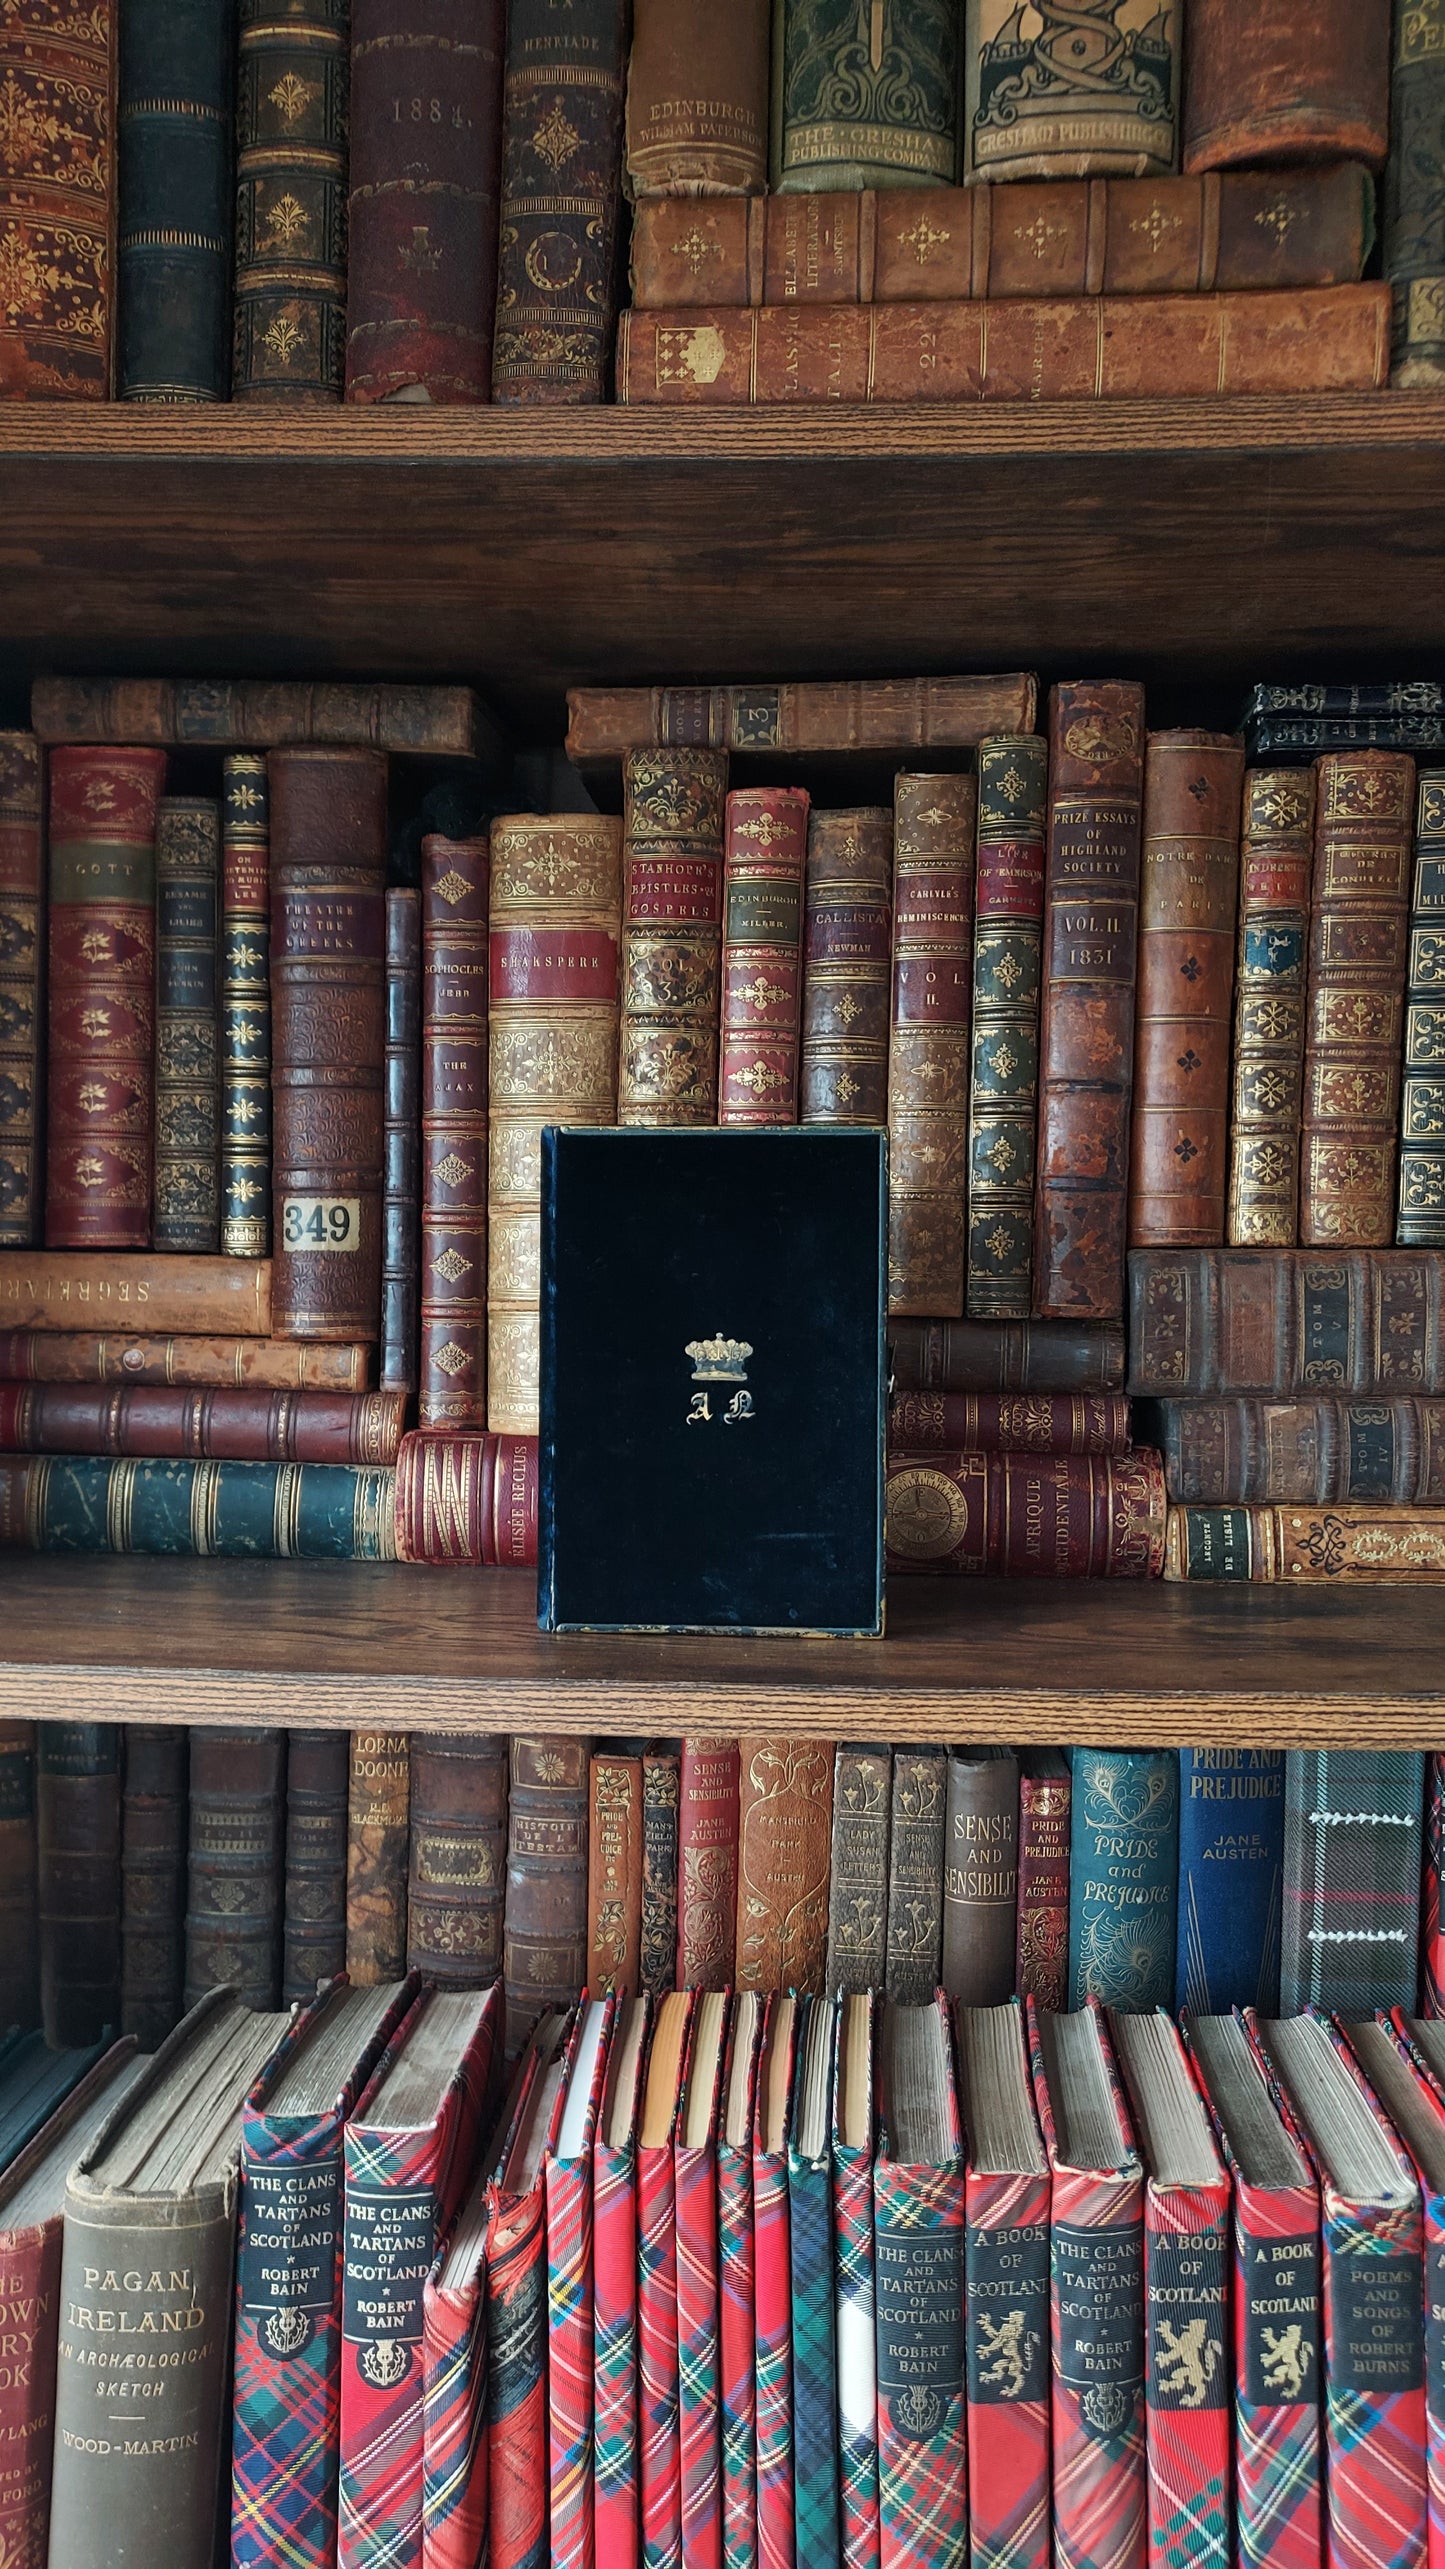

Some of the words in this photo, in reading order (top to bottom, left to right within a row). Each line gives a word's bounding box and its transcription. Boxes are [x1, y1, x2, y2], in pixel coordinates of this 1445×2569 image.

[524, 35, 599, 51] HENRIADE
[649, 99, 757, 127] EDINBURGH
[640, 121, 695, 142] WILLIAM
[790, 126, 834, 147] THE
[976, 125, 1053, 155] GRESHAM
[748, 707, 770, 723] 3
[1054, 812, 1089, 825] PRIZE
[1095, 812, 1136, 825] ESSAYS
[1086, 830, 1101, 840] OF
[1060, 844, 1128, 857] HIGHLAND
[1146, 852, 1195, 864] NOTRE
[237, 856, 251, 864] ON
[1357, 860, 1375, 868] DE
[979, 868, 993, 878] OF
[1063, 862, 1122, 874] SOCIETY
[1189, 874, 1205, 885] DE
[730, 895, 798, 905] EDINBURGH
[909, 886, 960, 899] CARLYLE'S
[284, 904, 354, 917] THEATRE
[630, 902, 710, 917] GOSPELS
[1160, 900, 1225, 911] PARIS
[291, 920, 309, 932] OF
[316, 920, 344, 932] THE
[816, 913, 886, 925] CALLISTA
[1065, 916, 1104, 934] VOL.
[285, 937, 354, 949] GREEKS
[827, 944, 872, 953] NEWMAN
[500, 956, 599, 968] SHAKSPERE
[1069, 948, 1113, 966] 1831
[424, 964, 485, 975] SOPHOCLES
[900, 971, 966, 985] VOL.
[442, 1061, 468, 1070] THE
[434, 1082, 474, 1092] AJAX
[284, 1203, 351, 1244] 349
[1312, 1303, 1323, 1349] TOM
[686, 1391, 714, 1425] A
[1357, 1432, 1369, 1474] TOM
[512, 1445, 527, 1503] RECLUS
[1026, 1478, 1041, 1559] AFRIQUE
[510, 1509, 526, 1558] ÉLISÉE
[1223, 1513, 1234, 1547] LISLE
[1224, 1556, 1234, 1571] DE
[354, 1736, 408, 1754] LORNA
[1192, 1747, 1244, 1770] PRIDE
[1248, 1748, 1281, 1769] AND
[353, 1759, 408, 1777] DOONE
[693, 1762, 731, 1775] SENSE
[700, 1776, 723, 1787] AND
[1190, 1774, 1281, 1800] PREJUDICE
[688, 1786, 734, 1801] SENSIBILITY
[602, 1811, 623, 1821] PRIDE
[696, 1817, 725, 1828] JANE
[954, 1812, 1012, 1843] SENSE
[1031, 1820, 1066, 1832] PRIDE
[524, 1831, 541, 1840] DE
[689, 1828, 732, 1841] AUSTEN
[850, 1829, 875, 1840] LADY
[906, 1833, 931, 1844] SENSE
[1037, 1834, 1059, 1844] AND
[1213, 1834, 1261, 1846] JANE
[600, 1845, 623, 1855] UDICE
[771, 1839, 801, 1849] PARK
[1025, 1845, 1070, 1858] PREJUDICE
[1093, 1835, 1159, 1859] PRIDE
[847, 1847, 879, 1857] SUSAN
[966, 1848, 1002, 1864] AND
[1202, 1847, 1269, 1860] AUSTEN
[843, 1862, 881, 1874] LETTERS
[1108, 1862, 1147, 1879] and
[1031, 1875, 1062, 1885] JANE
[1025, 1886, 1068, 1898] AUSTEN
[1082, 1880, 1171, 1912] PREJUDICE
[249, 2176, 282, 2192] THE
[286, 2173, 337, 2193] CLANS
[278, 2194, 308, 2205] AND
[254, 2202, 332, 2221] TARTANS
[347, 2202, 377, 2221] THE
[380, 2205, 432, 2222] CLANS
[282, 2223, 301, 2234] OF
[372, 2223, 403, 2235] AND
[974, 2231, 992, 2247] A
[995, 2225, 1048, 2246] BOOK
[249, 2230, 334, 2249] SCOTLAND
[350, 2232, 427, 2252] TARTANS
[1155, 2235, 1172, 2250] A
[876, 2245, 908, 2263] THE
[1056, 2238, 1091, 2260] THE
[1094, 2240, 1142, 2260] CLANS
[1254, 2248, 1268, 2264] A
[1271, 2242, 1315, 2263] BOOK
[378, 2254, 396, 2265] OF
[999, 2254, 1024, 2269] OF
[261, 2266, 320, 2282] ROBERT
[346, 2262, 430, 2282] SCOTLAND
[903, 2266, 935, 2277] AND
[1087, 2262, 1117, 2273] AND
[1179, 2260, 1203, 2276] OF
[83, 2267, 191, 2293] PAGAN
[1062, 2271, 1141, 2290] TARTANS
[1274, 2270, 1297, 2287] OF
[1350, 2270, 1413, 2285] POEMS
[270, 2283, 309, 2296] BAIN
[879, 2276, 959, 2295] TARTANS
[909, 2297, 928, 2308] OF
[1093, 2292, 1112, 2304] OF
[1364, 2289, 1400, 2302] AND
[356, 2300, 417, 2314] ROBERT
[1060, 2300, 1142, 2321] SCOTLAND
[1250, 2295, 1318, 2316] SCOTLAND
[1352, 2305, 1412, 2320] SONGS
[67, 2302, 206, 2333] IRELAND
[366, 2315, 406, 2329] BAIN
[1371, 2324, 1395, 2338] OF
[58, 2340, 73, 2359] AN
[888, 2344, 950, 2359] ROBERT
[1074, 2338, 1133, 2356] ROBERT
[1348, 2342, 1414, 2356] ROBERT
[899, 2360, 939, 2374] BAIN
[1084, 2356, 1123, 2371] BAIN
[1352, 2359, 1411, 2374] BURNS
[96, 2380, 165, 2398] SKETCH
[8, 2413, 48, 2441] LANG
[62, 2428, 199, 2456] WOOD-MARTIN
